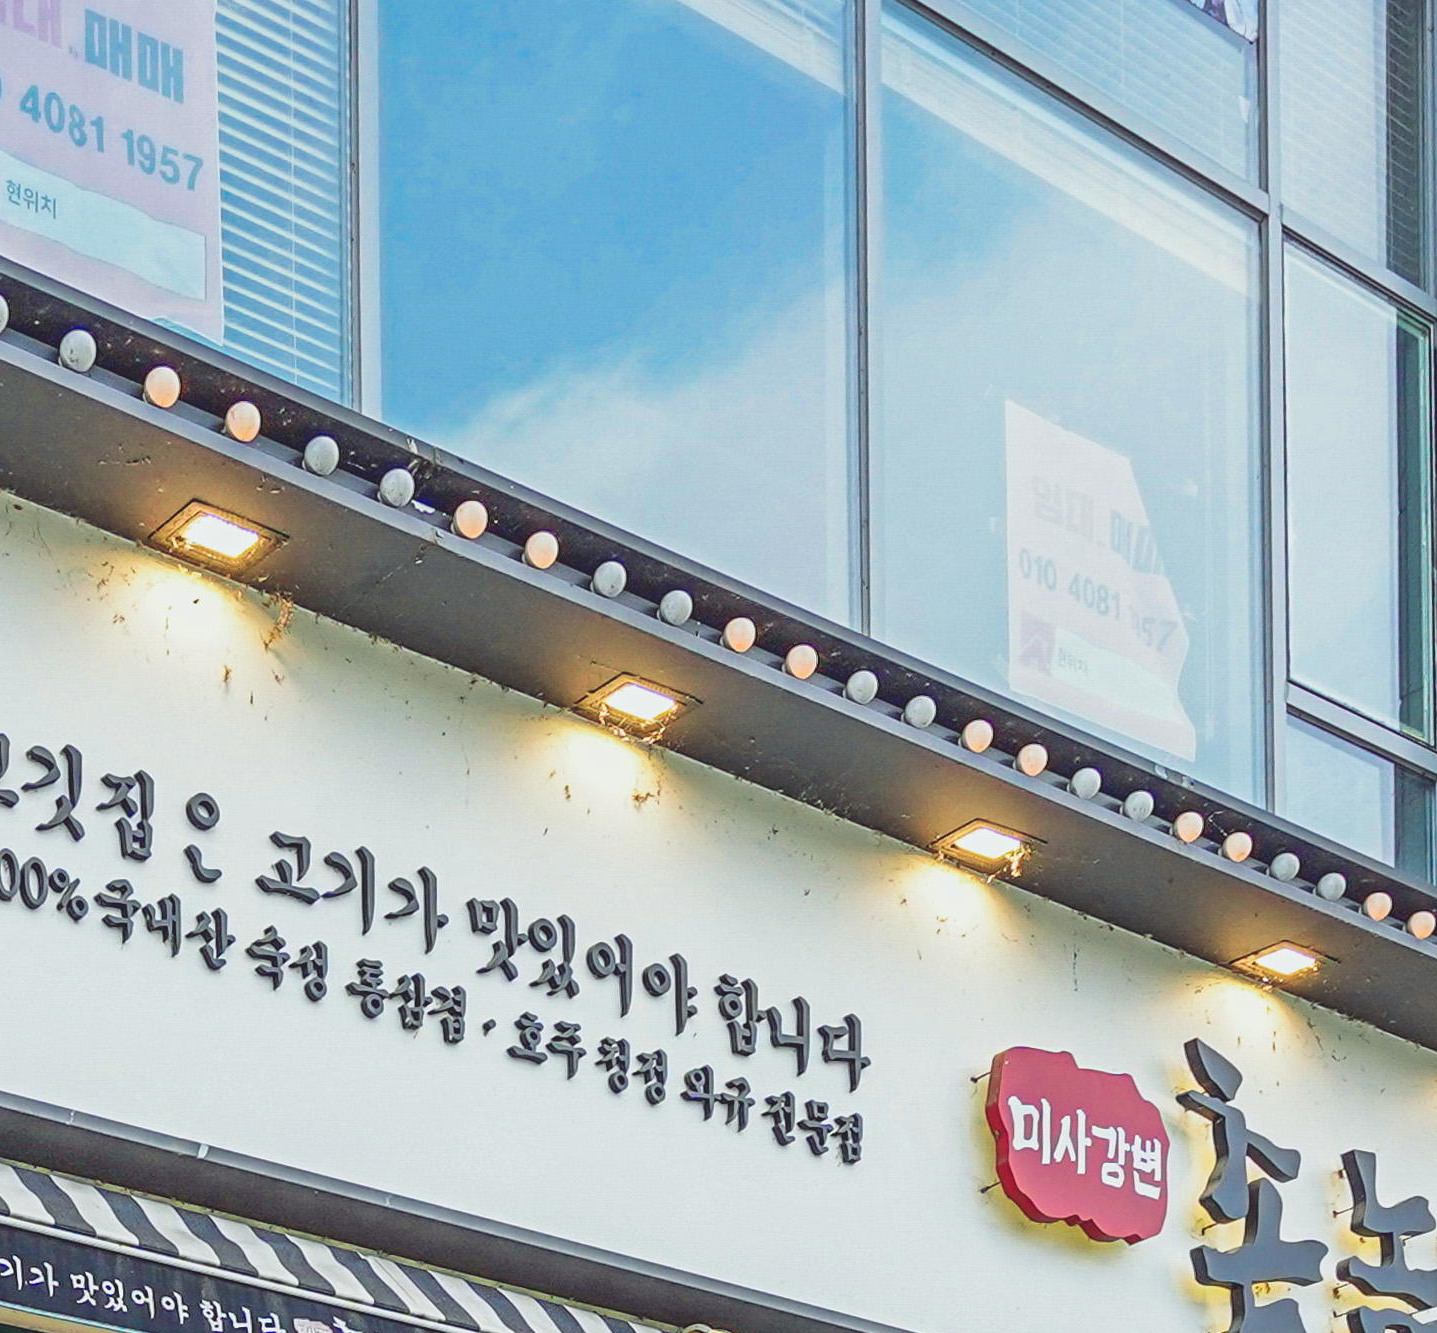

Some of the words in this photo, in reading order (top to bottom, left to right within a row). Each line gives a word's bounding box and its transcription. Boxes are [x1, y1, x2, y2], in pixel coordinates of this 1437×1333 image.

[84, 9, 184, 104] 매매
[19, 85, 106, 154] 4081
[119, 128, 204, 191] 1957
[6, 179, 58, 220] 현위치
[1019, 547, 1057, 591] 010
[1068, 573, 1120, 621] 4081
[255, 831, 449, 954] 고기가
[466, 897, 699, 1037] 맛있어야
[715, 973, 872, 1094] 합니다
[246, 925, 329, 1002] 숙성
[345, 958, 468, 1045] 통삼겹
[507, 1011, 587, 1080] 호주
[596, 1037, 669, 1106] 청정
[680, 1064, 757, 1132] 와규
[764, 1091, 864, 1165] 전문점
[1008, 1095, 1164, 1200] 미사강변
[70, 1272, 189, 1325] 맛있어야
